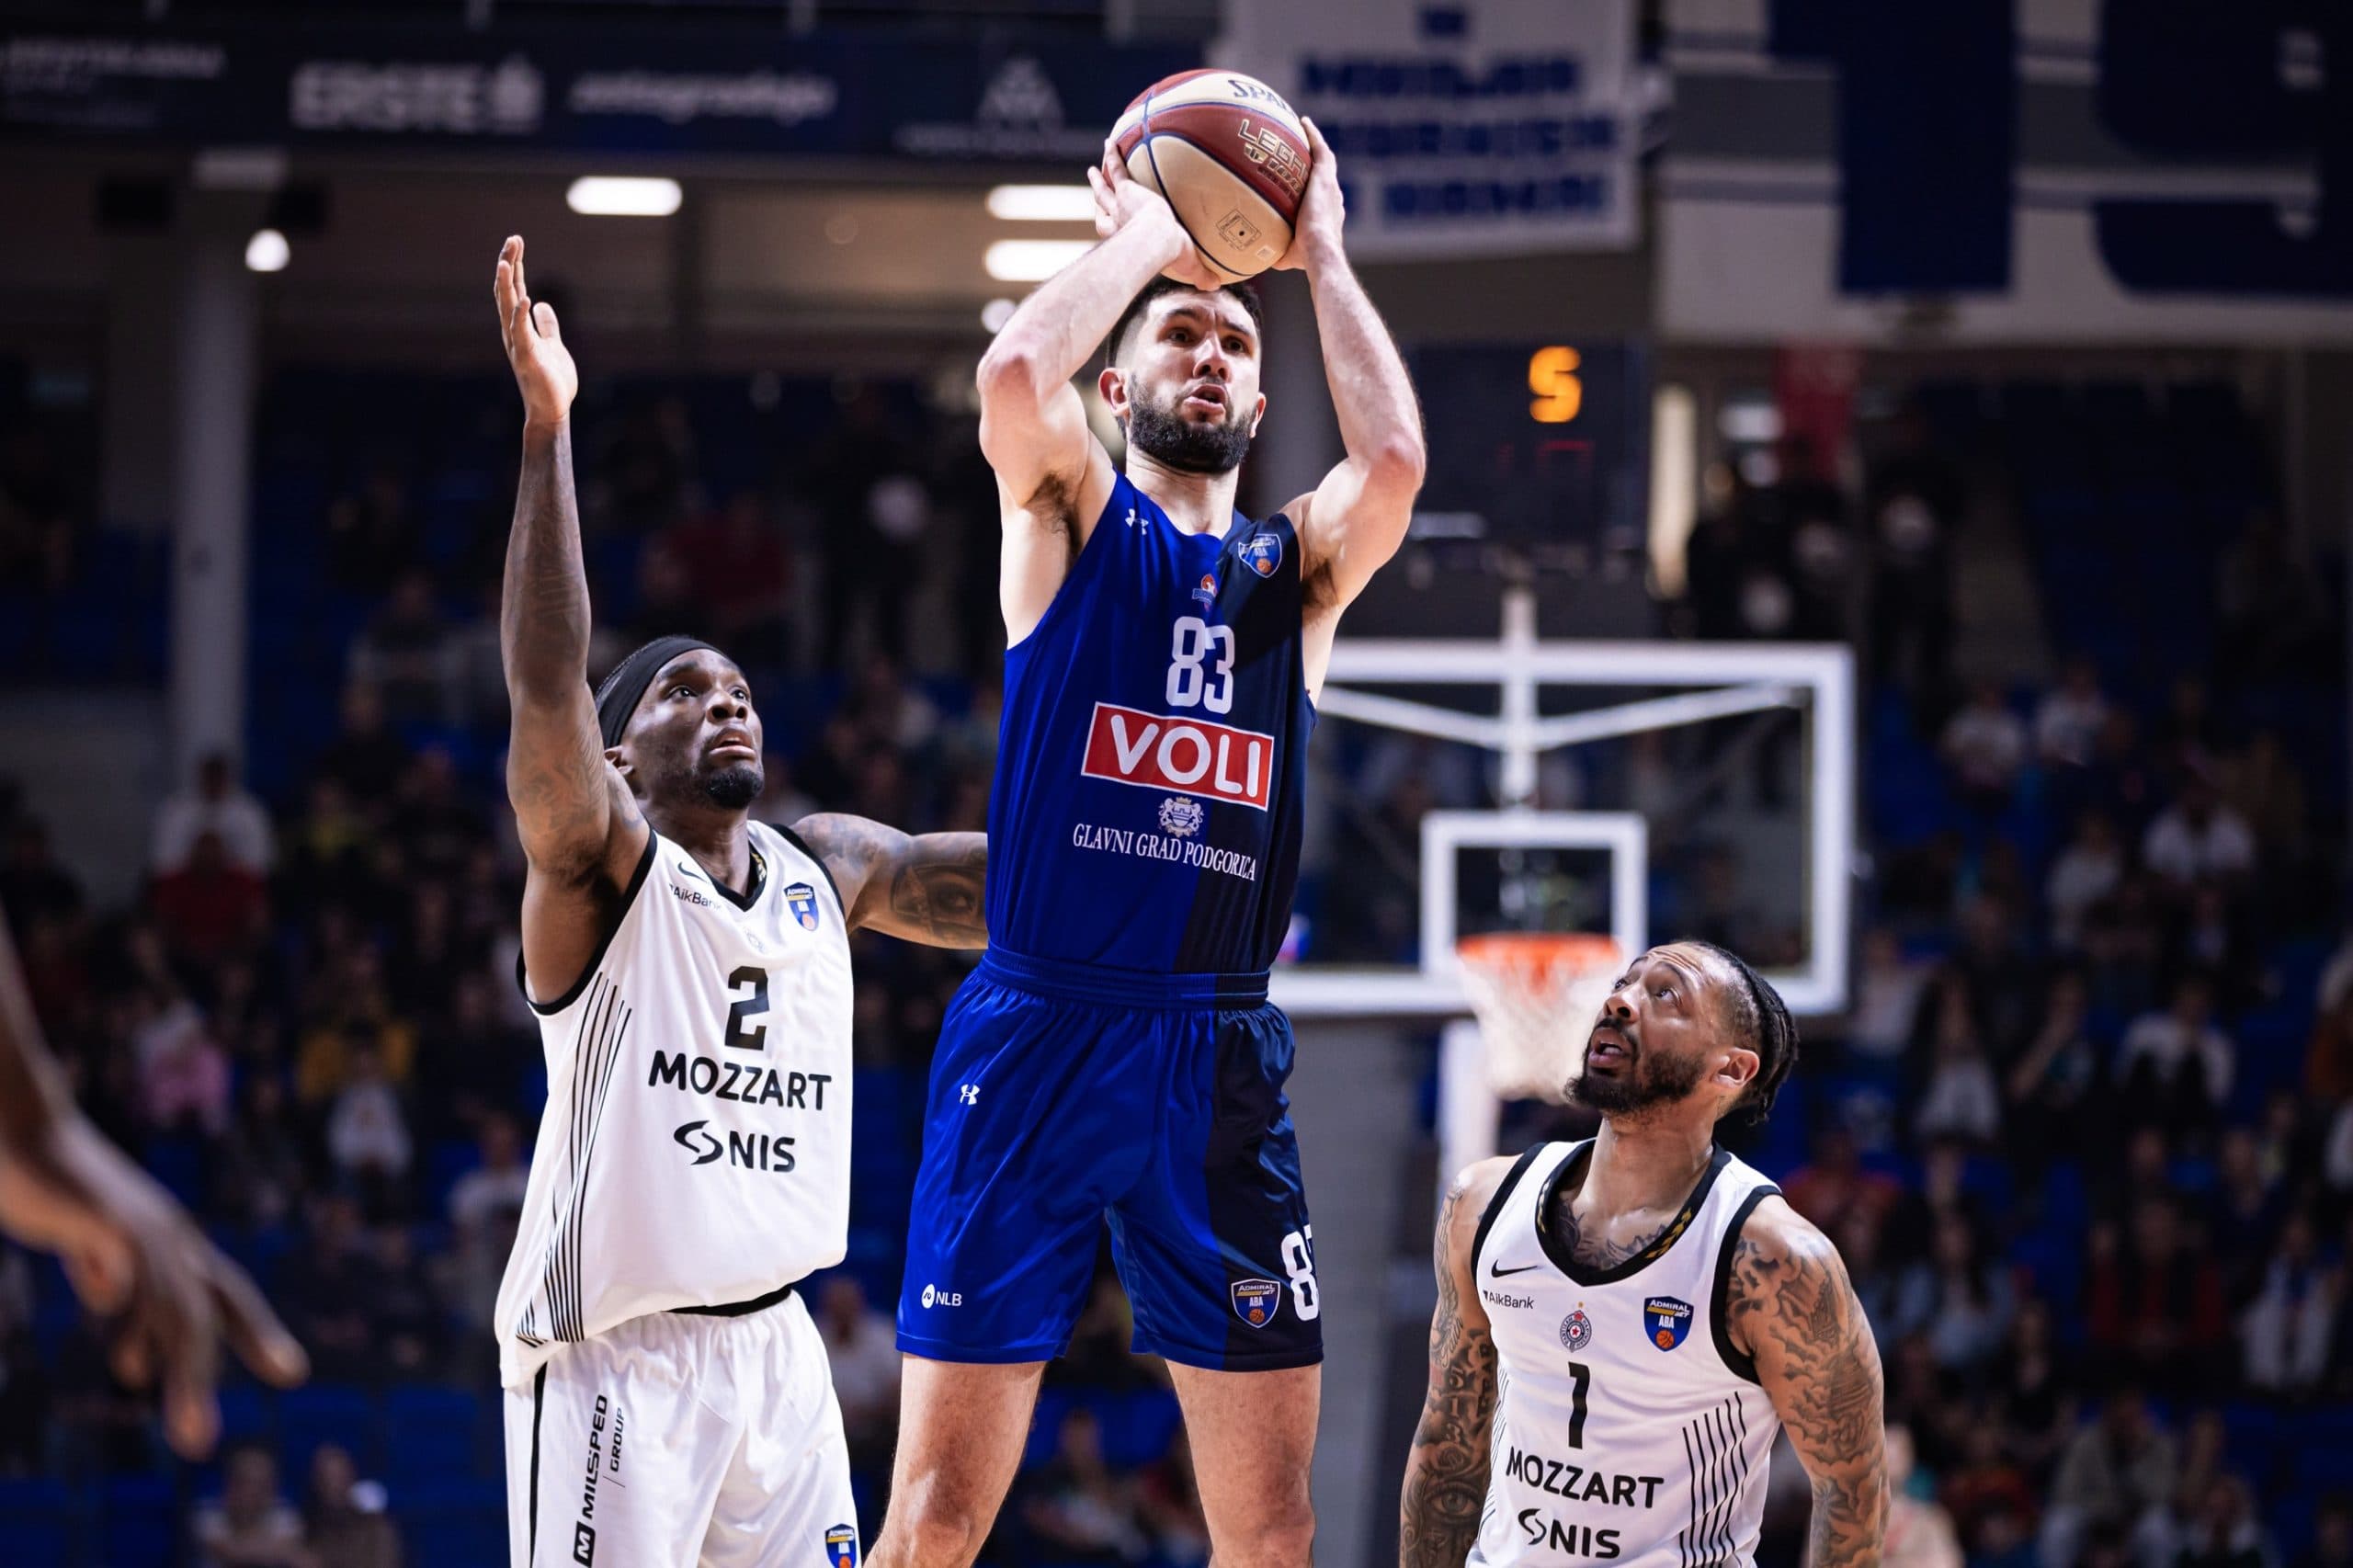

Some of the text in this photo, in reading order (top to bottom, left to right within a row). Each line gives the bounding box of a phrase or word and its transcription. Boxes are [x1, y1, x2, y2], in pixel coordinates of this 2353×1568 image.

[1165, 616, 1235, 715] 83
[1110, 714, 1261, 798] VOLI
[1073, 824, 1257, 881] GLAVNI GRAD PODGORICA
[674, 886, 722, 909] AikBa
[724, 966, 770, 1051] 2
[648, 1050, 832, 1110] MOZZART
[729, 1131, 796, 1173] NIS
[936, 1291, 962, 1307] NLB
[1249, 1296, 1264, 1307] ABA
[1489, 1291, 1535, 1310] AikBank
[1650, 1300, 1690, 1313] ADMIRAL
[1658, 1315, 1675, 1329] ABA
[1568, 1361, 1590, 1449] 1
[609, 1407, 625, 1472] GROUP
[1506, 1446, 1665, 1509] MOZZART
[1550, 1519, 1620, 1560] NIS
